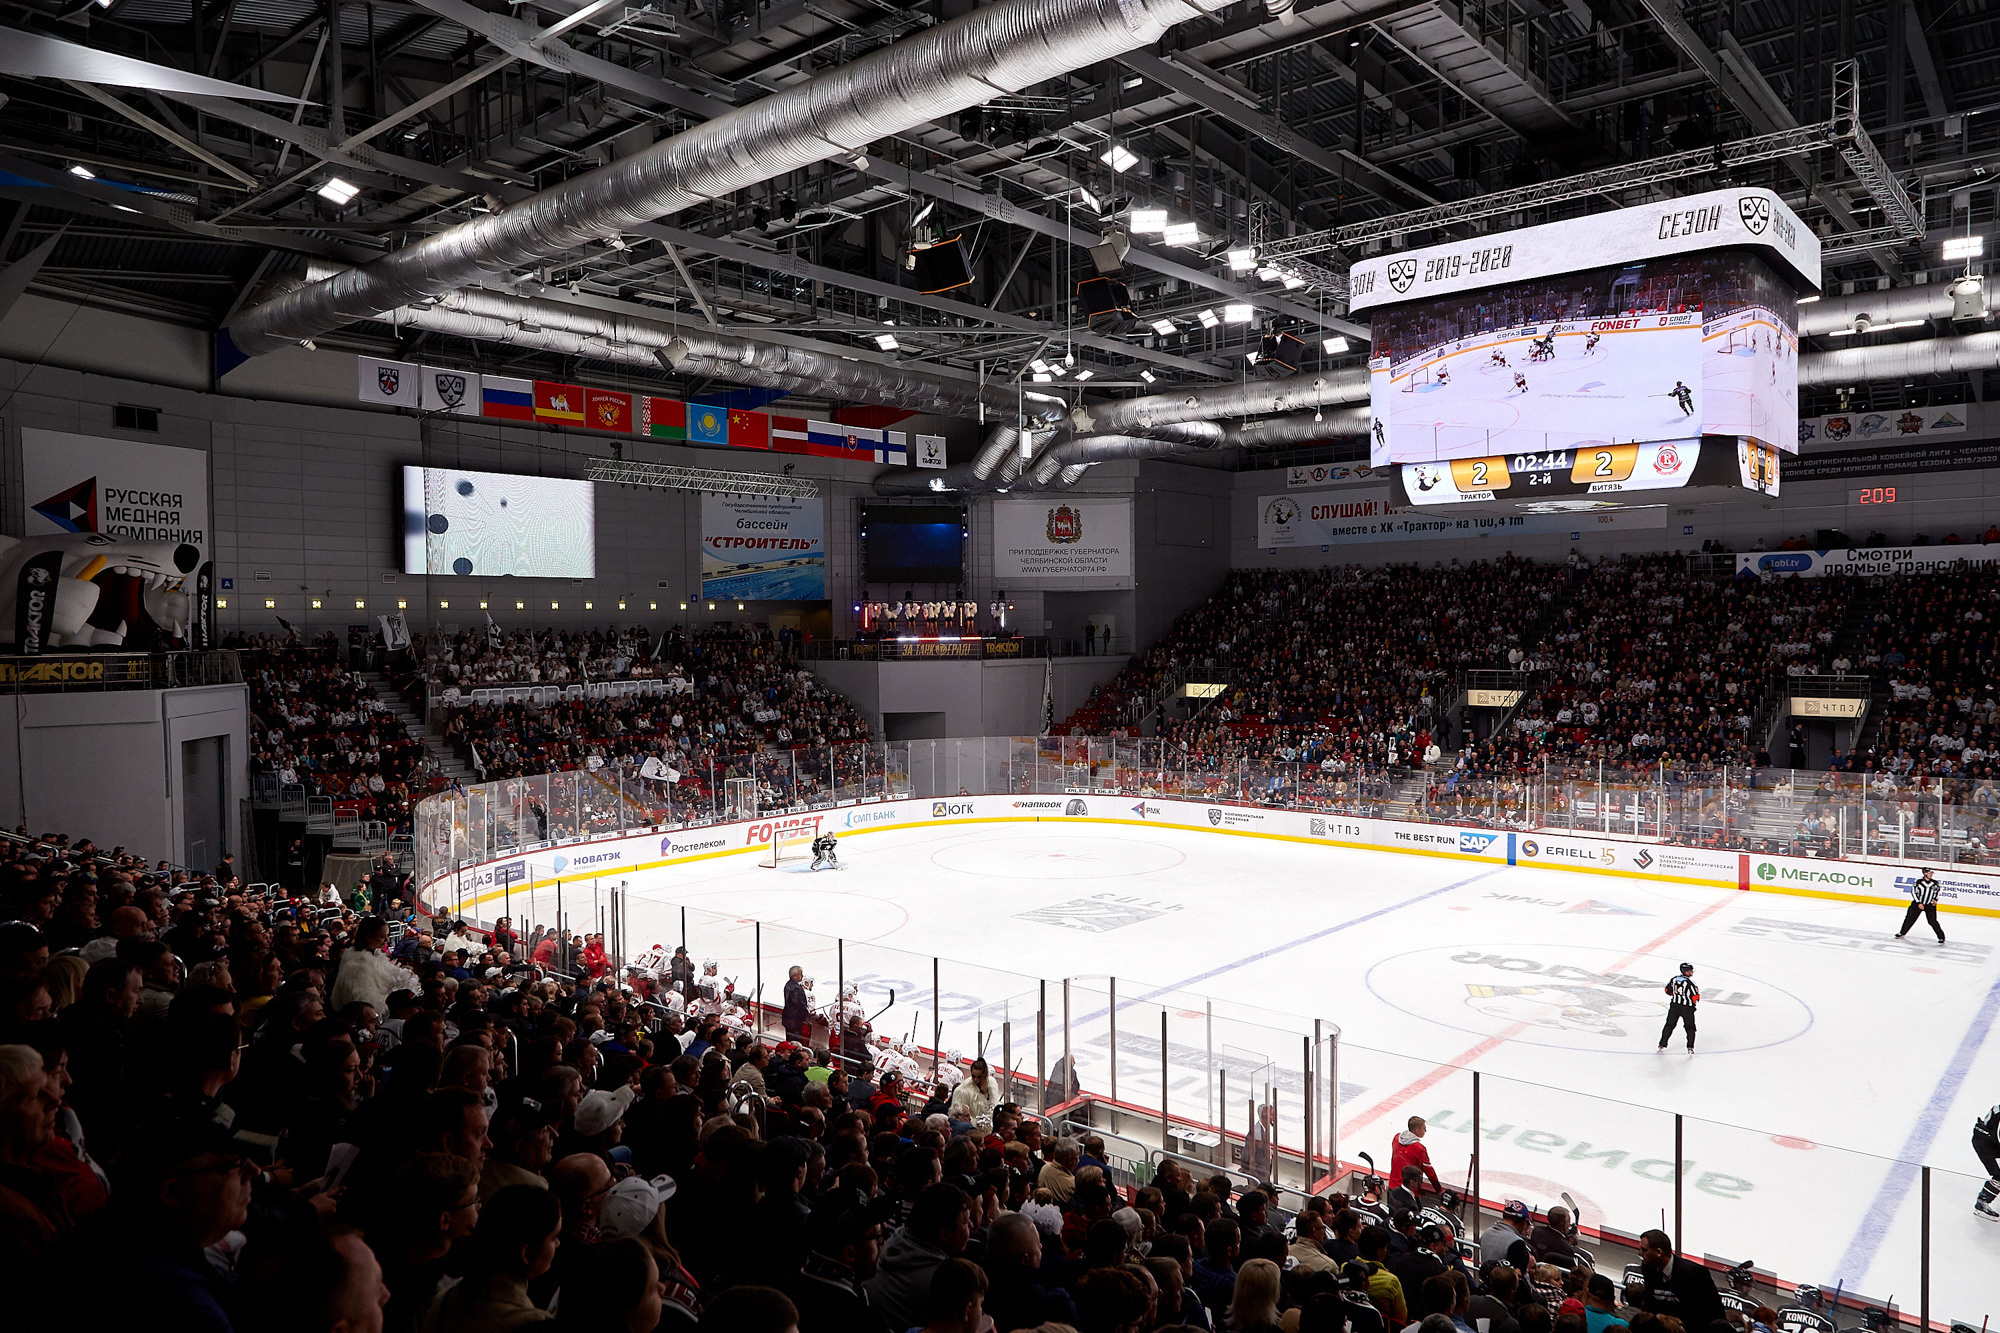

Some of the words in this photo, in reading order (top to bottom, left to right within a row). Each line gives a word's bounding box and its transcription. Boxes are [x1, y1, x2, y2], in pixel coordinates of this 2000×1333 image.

[1659, 204, 1722, 240] СЕЗОН
[1424, 245, 1513, 282] 2019-2020
[1350, 270, 1376, 299] ЗОН
[1591, 319, 1640, 331] FONBET
[1496, 331, 1520, 339] СОГАЗ
[380, 368, 398, 377] МХЛ
[1514, 452, 1567, 472] 02:44
[1595, 452, 1612, 476] 2
[1784, 468, 1815, 477] ХОККЕЮ
[1817, 466, 1841, 475] СРЕДИ
[1843, 463, 1882, 473] МУЖСКИХ
[1884, 461, 1918, 471] КОМАНД
[1920, 458, 1951, 467] СЕЗОНА
[1953, 455, 1997, 465] 2019/2020
[1803, 454, 1878, 467] КОНТИНЕНТАЛЬНОЙ
[1879, 450, 1927, 461] ХОККЕЙНОЙ
[1929, 448, 1950, 456] ЛИГИ
[1471, 462, 1488, 486] 2
[1529, 472, 1552, 486] 2-й
[104, 487, 183, 509] РУССКАЯ
[1460, 493, 1491, 501] ТРАКТОР
[105, 506, 181, 526] МЕДНАЯ
[1311, 499, 1378, 520] СЛУШАЙ!
[736, 518, 788, 530] бассейн
[1332, 523, 1368, 537] вместе
[1380, 522, 1394, 533] ХК
[1397, 521, 1453, 533] «Трактор»
[1456, 520, 1469, 529] на
[1824, 562, 1891, 576] прямые
[24, 589, 46, 654] TRAKTOR
[1823, 704, 1854, 712] ЧТПЗ
[853, 812, 872, 823] СМП
[874, 810, 896, 821] БАНК
[949, 803, 974, 815] ЮГК
[1146, 807, 1161, 815] РМК
[746, 816, 824, 845] FONBET
[1328, 824, 1360, 836] ЧТПЗ
[671, 838, 726, 854] Ростелеком
[1394, 832, 1411, 841] THE
[1413, 834, 1435, 843] BEST
[1437, 836, 1455, 845] RUN
[1461, 835, 1490, 851] SAP
[574, 852, 621, 865] НОВАТЭК
[1546, 846, 1597, 859] ERIELL
[1601, 847, 1615, 866] 15
[1937, 880, 1990, 889] ЕЛЯБИНСКИЙ
[1785, 1311, 1820, 1328] KONKOV
